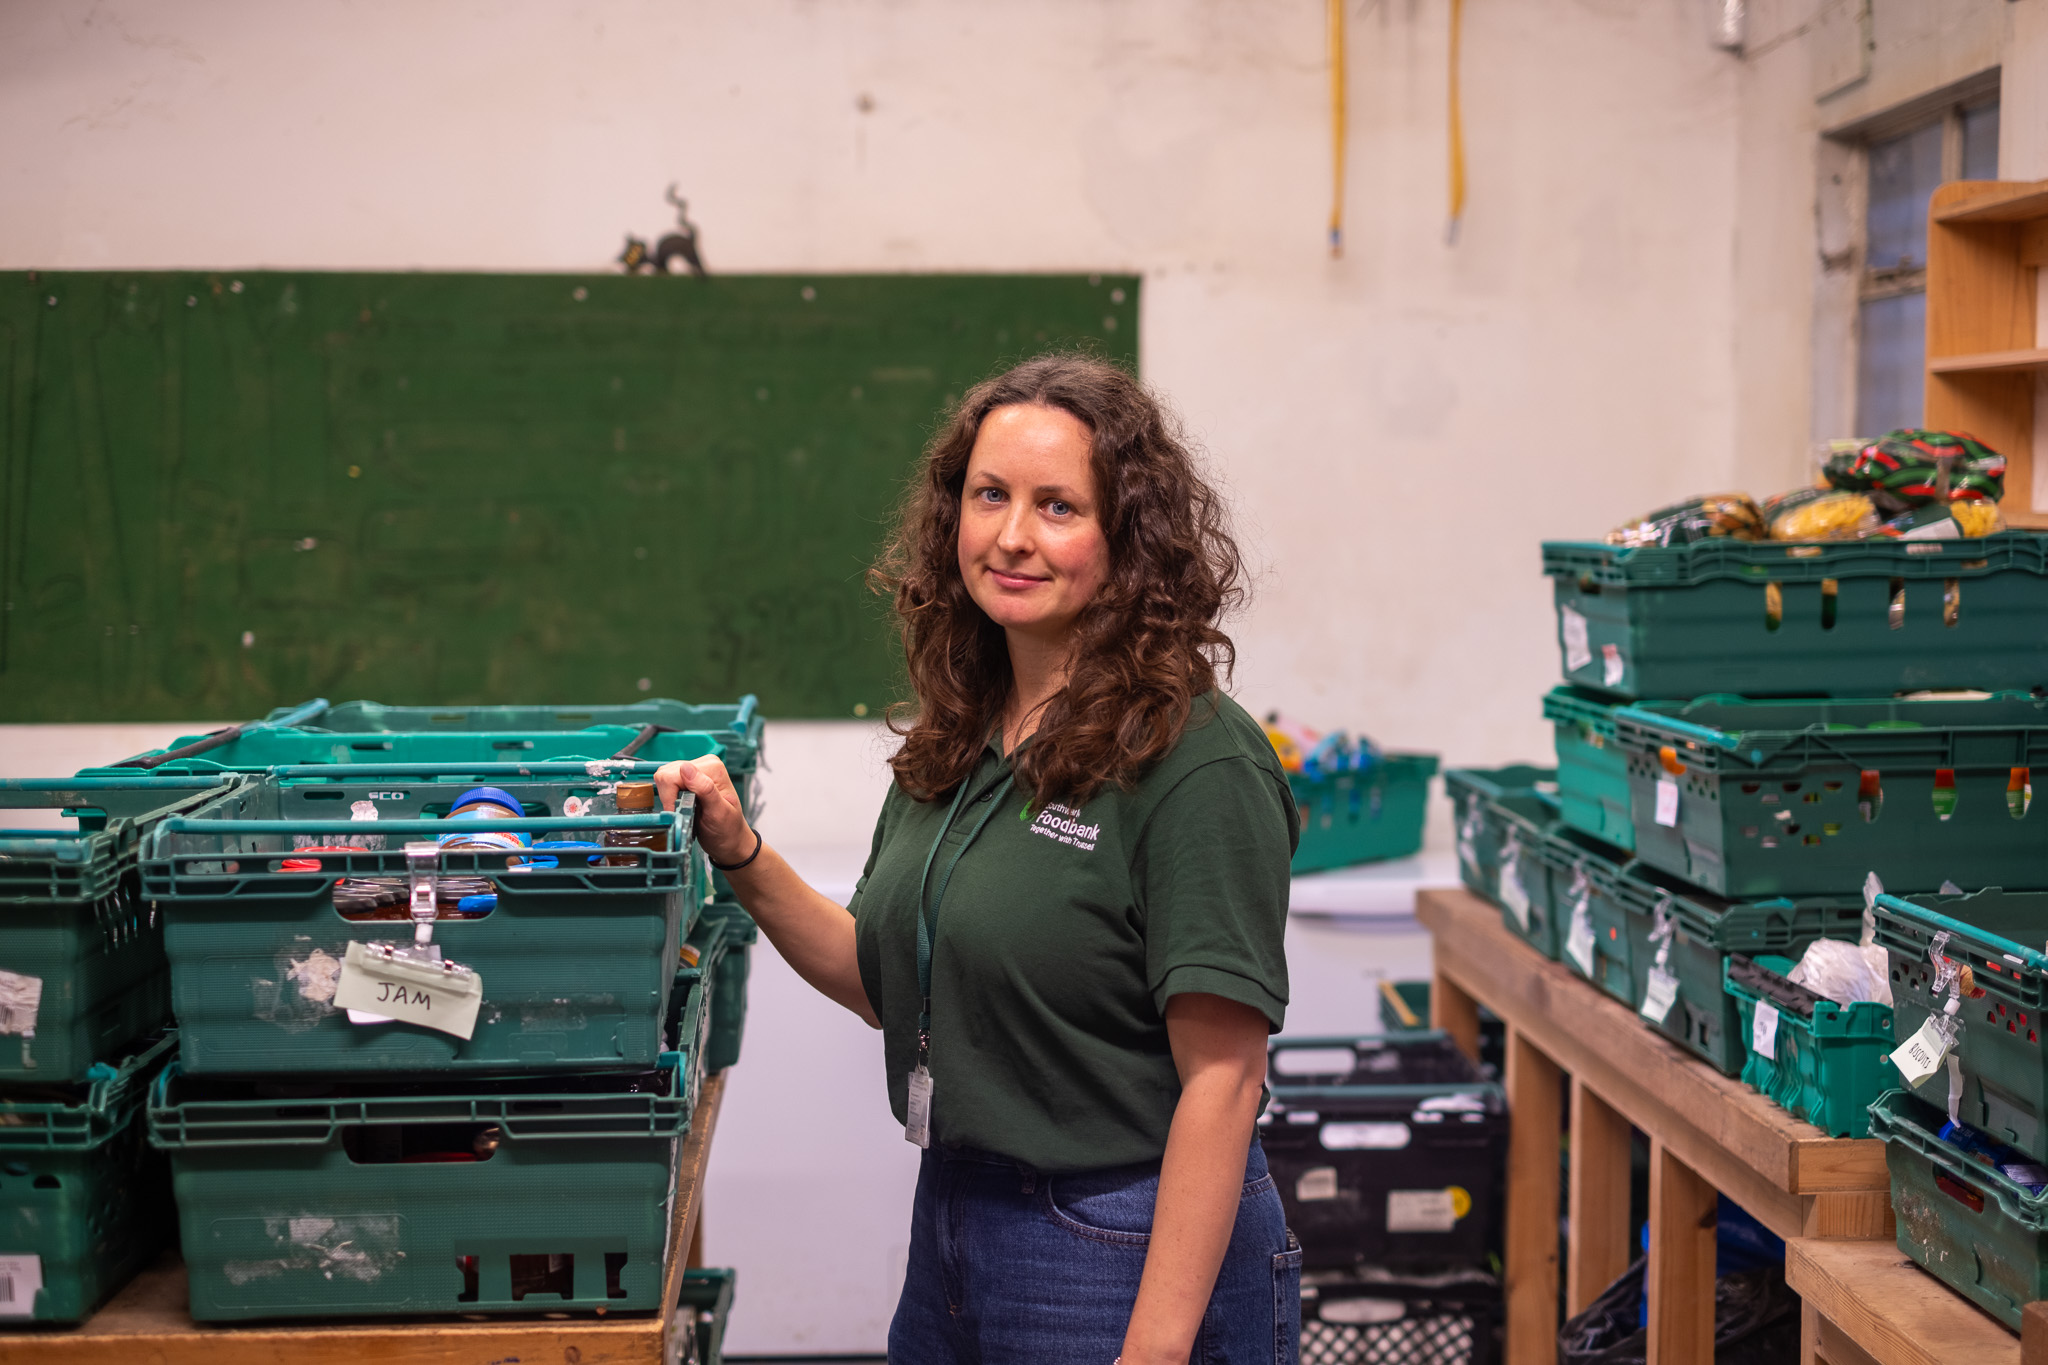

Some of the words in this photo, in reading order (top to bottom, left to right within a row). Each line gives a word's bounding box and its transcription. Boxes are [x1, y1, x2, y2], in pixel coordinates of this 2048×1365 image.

[1030, 824, 1059, 839] Together
[1058, 835, 1073, 845] with
[1036, 810, 1100, 841] Foodbank
[377, 982, 430, 1010] JAM
[1908, 1042, 1931, 1069] BISCUITS
